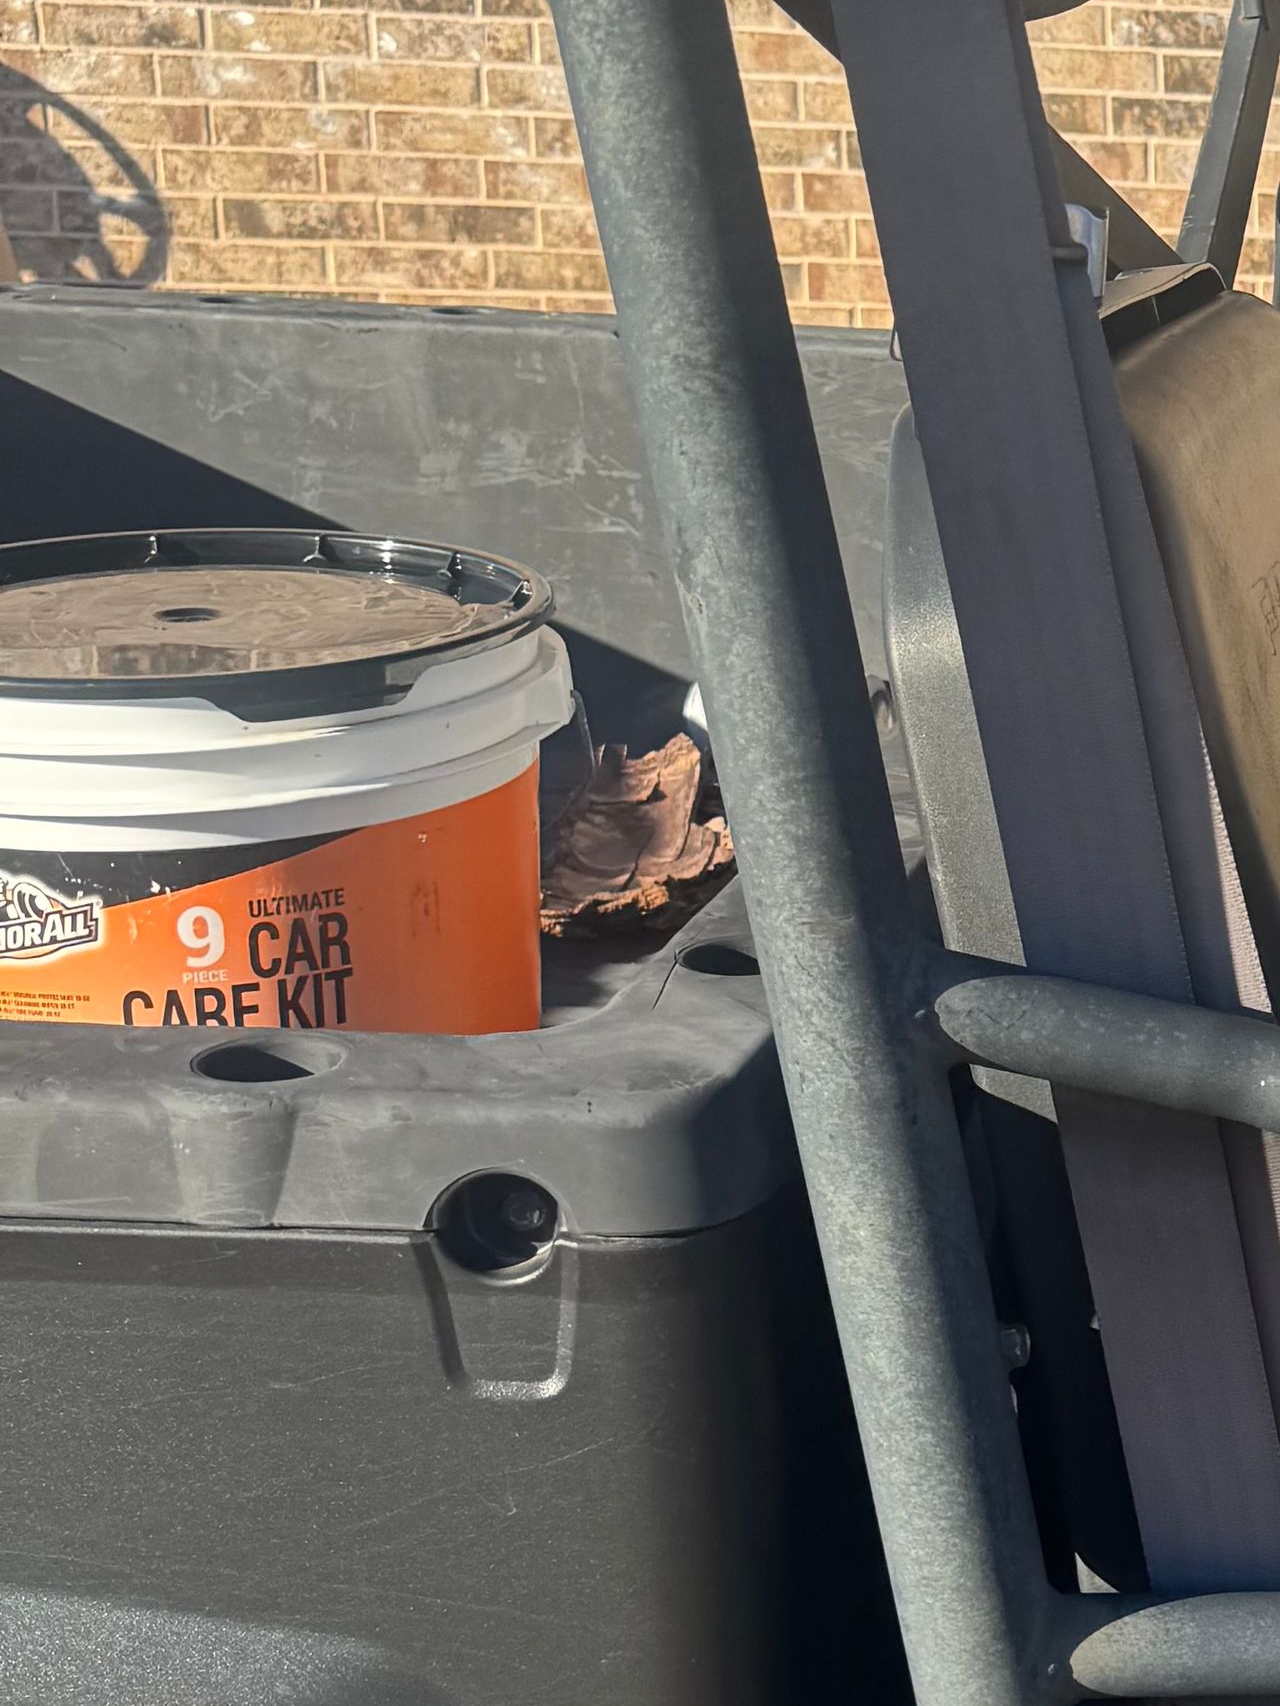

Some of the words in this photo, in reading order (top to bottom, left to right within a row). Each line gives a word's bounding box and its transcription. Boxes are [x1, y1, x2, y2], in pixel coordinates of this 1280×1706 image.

[248, 888, 346, 919] ULTIMATE
[177, 906, 226, 968] 9
[248, 912, 352, 979] CAR
[182, 969, 228, 984] PIECE
[277, 967, 353, 1029] KIT
